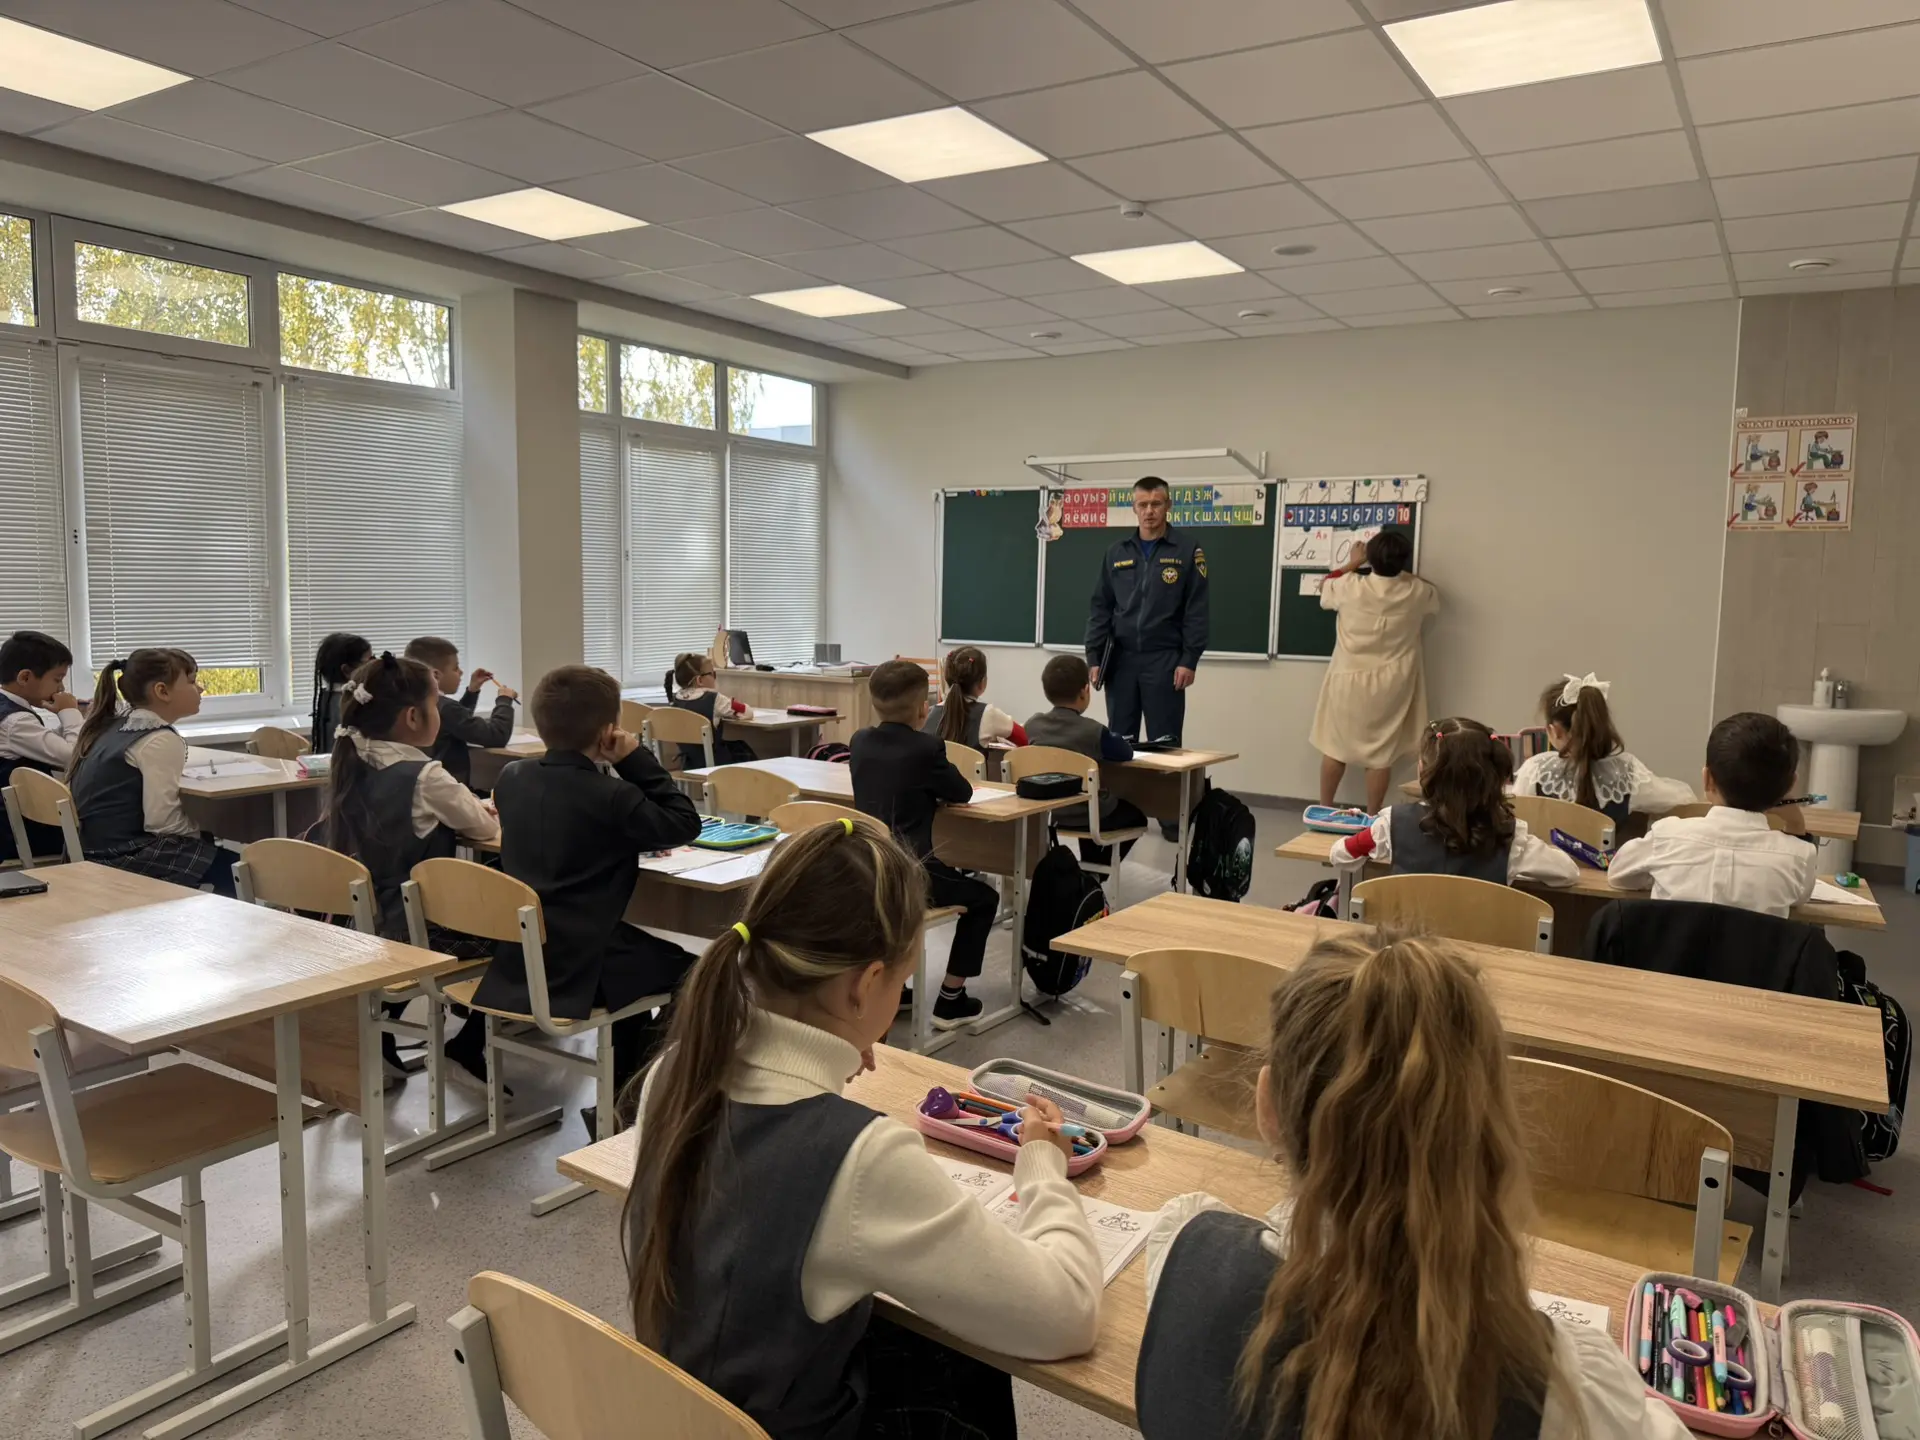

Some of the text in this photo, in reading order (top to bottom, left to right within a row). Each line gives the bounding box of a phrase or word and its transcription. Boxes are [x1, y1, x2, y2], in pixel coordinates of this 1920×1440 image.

[1776, 417, 1854, 428] ПРАВИЛЬНО
[1299, 508, 1303, 521] 1
[1308, 510, 1315, 522] 2
[1320, 509, 1326, 522] 3
[1330, 509, 1338, 521] 4
[1342, 509, 1348, 521] 5
[1353, 509, 1360, 521] 6
[1365, 509, 1372, 521] 7
[1376, 508, 1383, 521] 8
[1388, 508, 1394, 521] 9
[1400, 508, 1410, 521] 10
